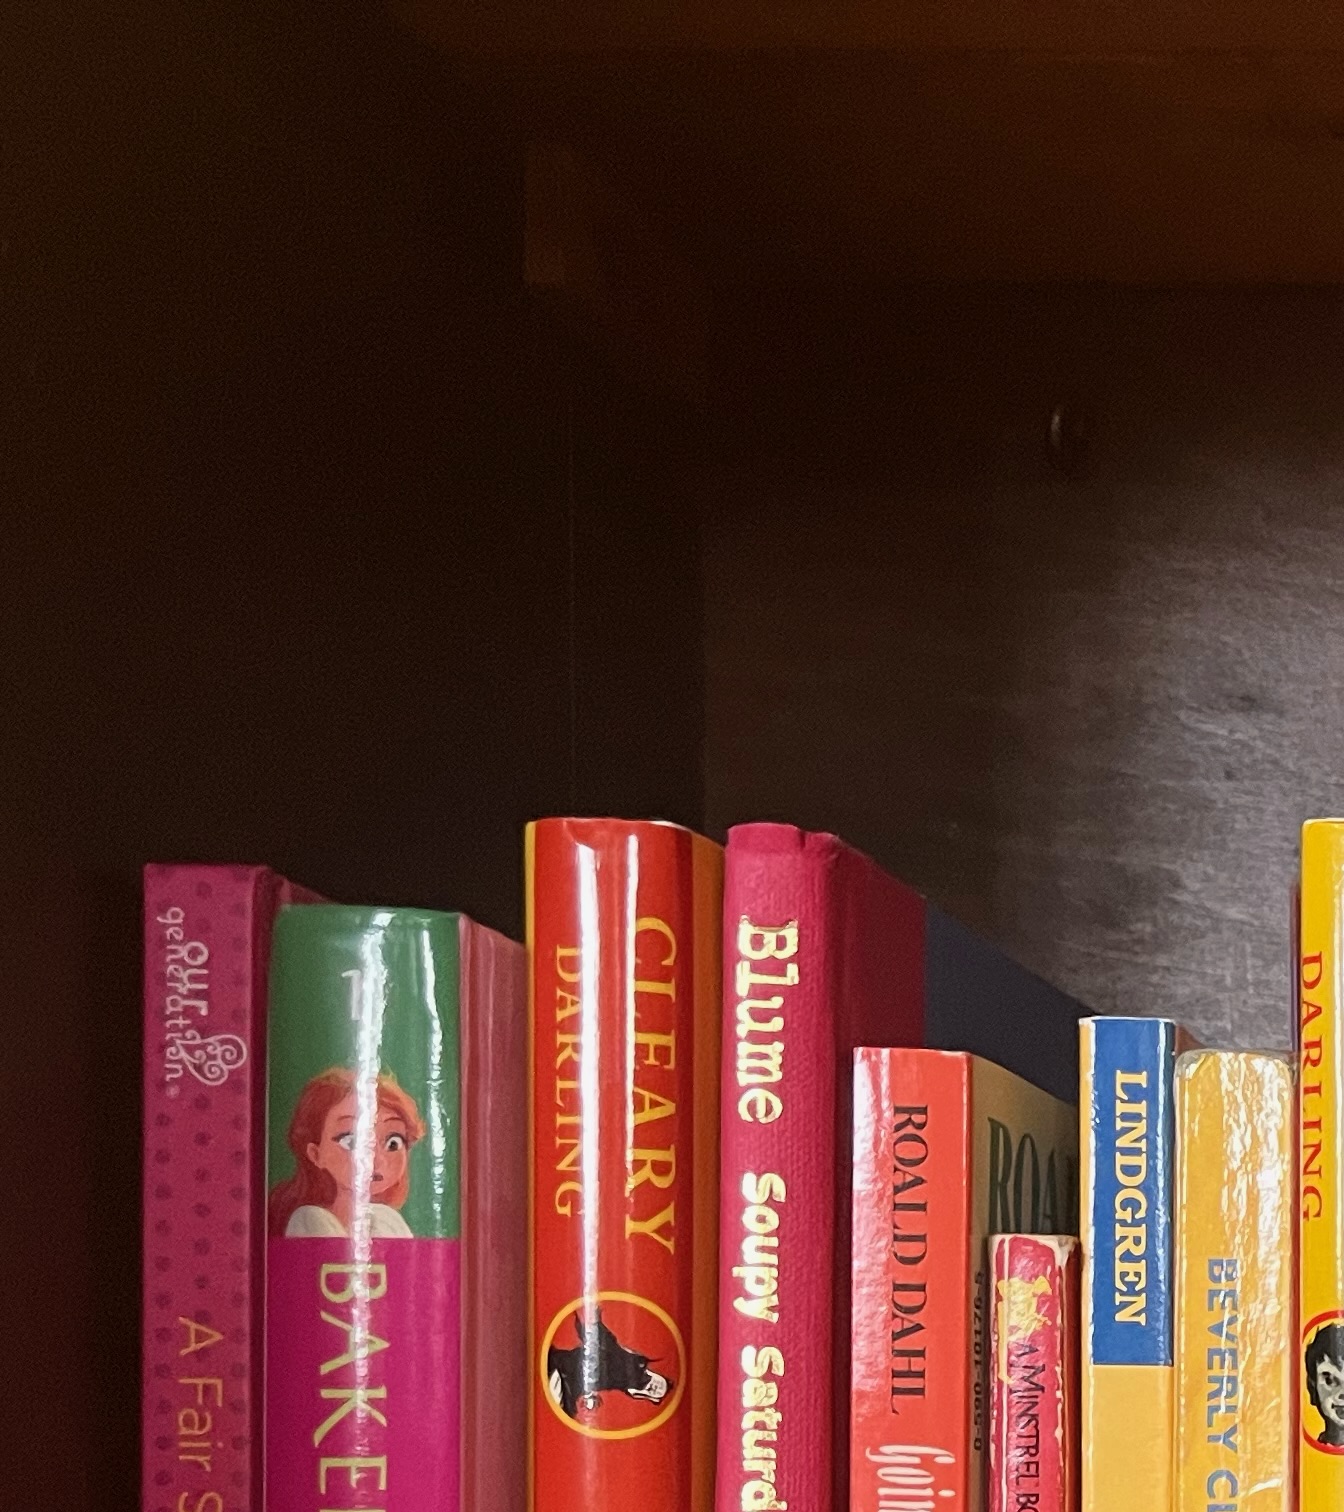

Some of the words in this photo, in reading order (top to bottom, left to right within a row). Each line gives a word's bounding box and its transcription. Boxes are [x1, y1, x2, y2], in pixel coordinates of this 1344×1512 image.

[734, 916, 799, 1124] Blume
[891, 1103, 928, 1266] ROALD
[1114, 1070, 1147, 1326] LINDGREN
[178, 1317, 223, 1356] A
[891, 1280, 928, 1415] DAHL
[1207, 1259, 1238, 1453] BEVERLY
[178, 1379, 221, 1472] Fair
